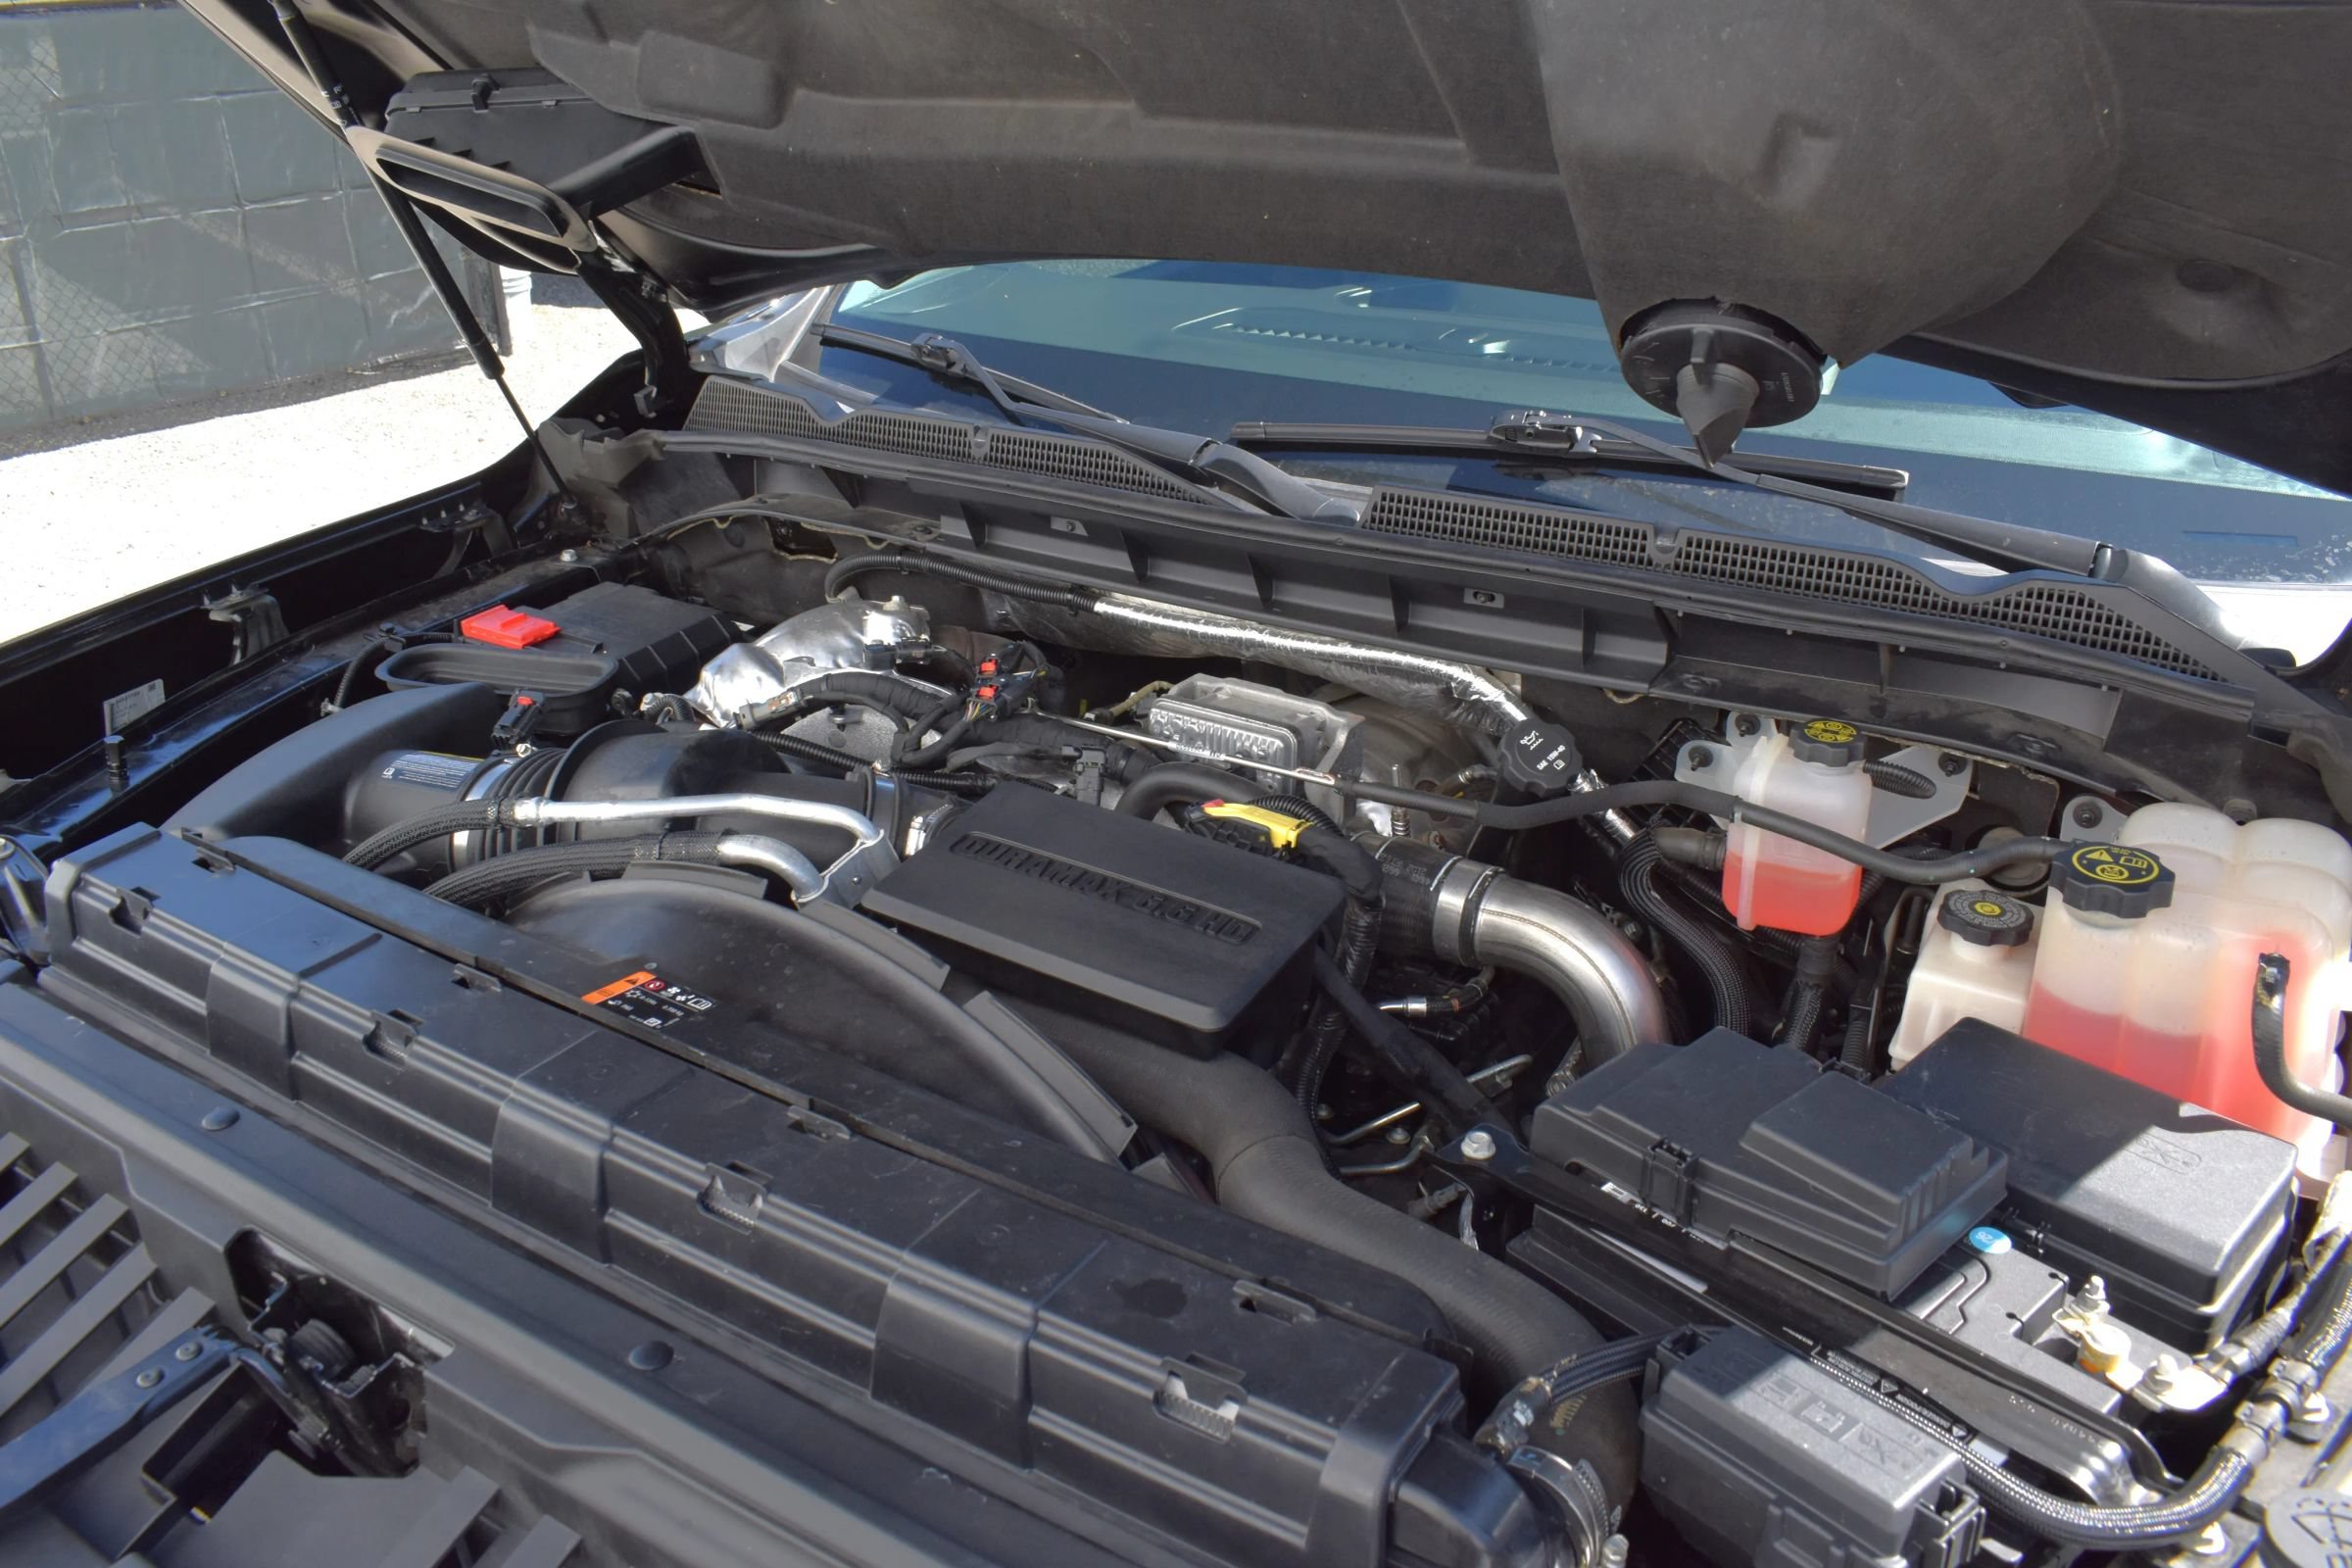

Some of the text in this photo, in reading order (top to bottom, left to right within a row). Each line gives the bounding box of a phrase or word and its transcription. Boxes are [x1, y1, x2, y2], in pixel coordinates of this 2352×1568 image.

[950, 834, 1255, 945] DURAMAX 6.6 HD
